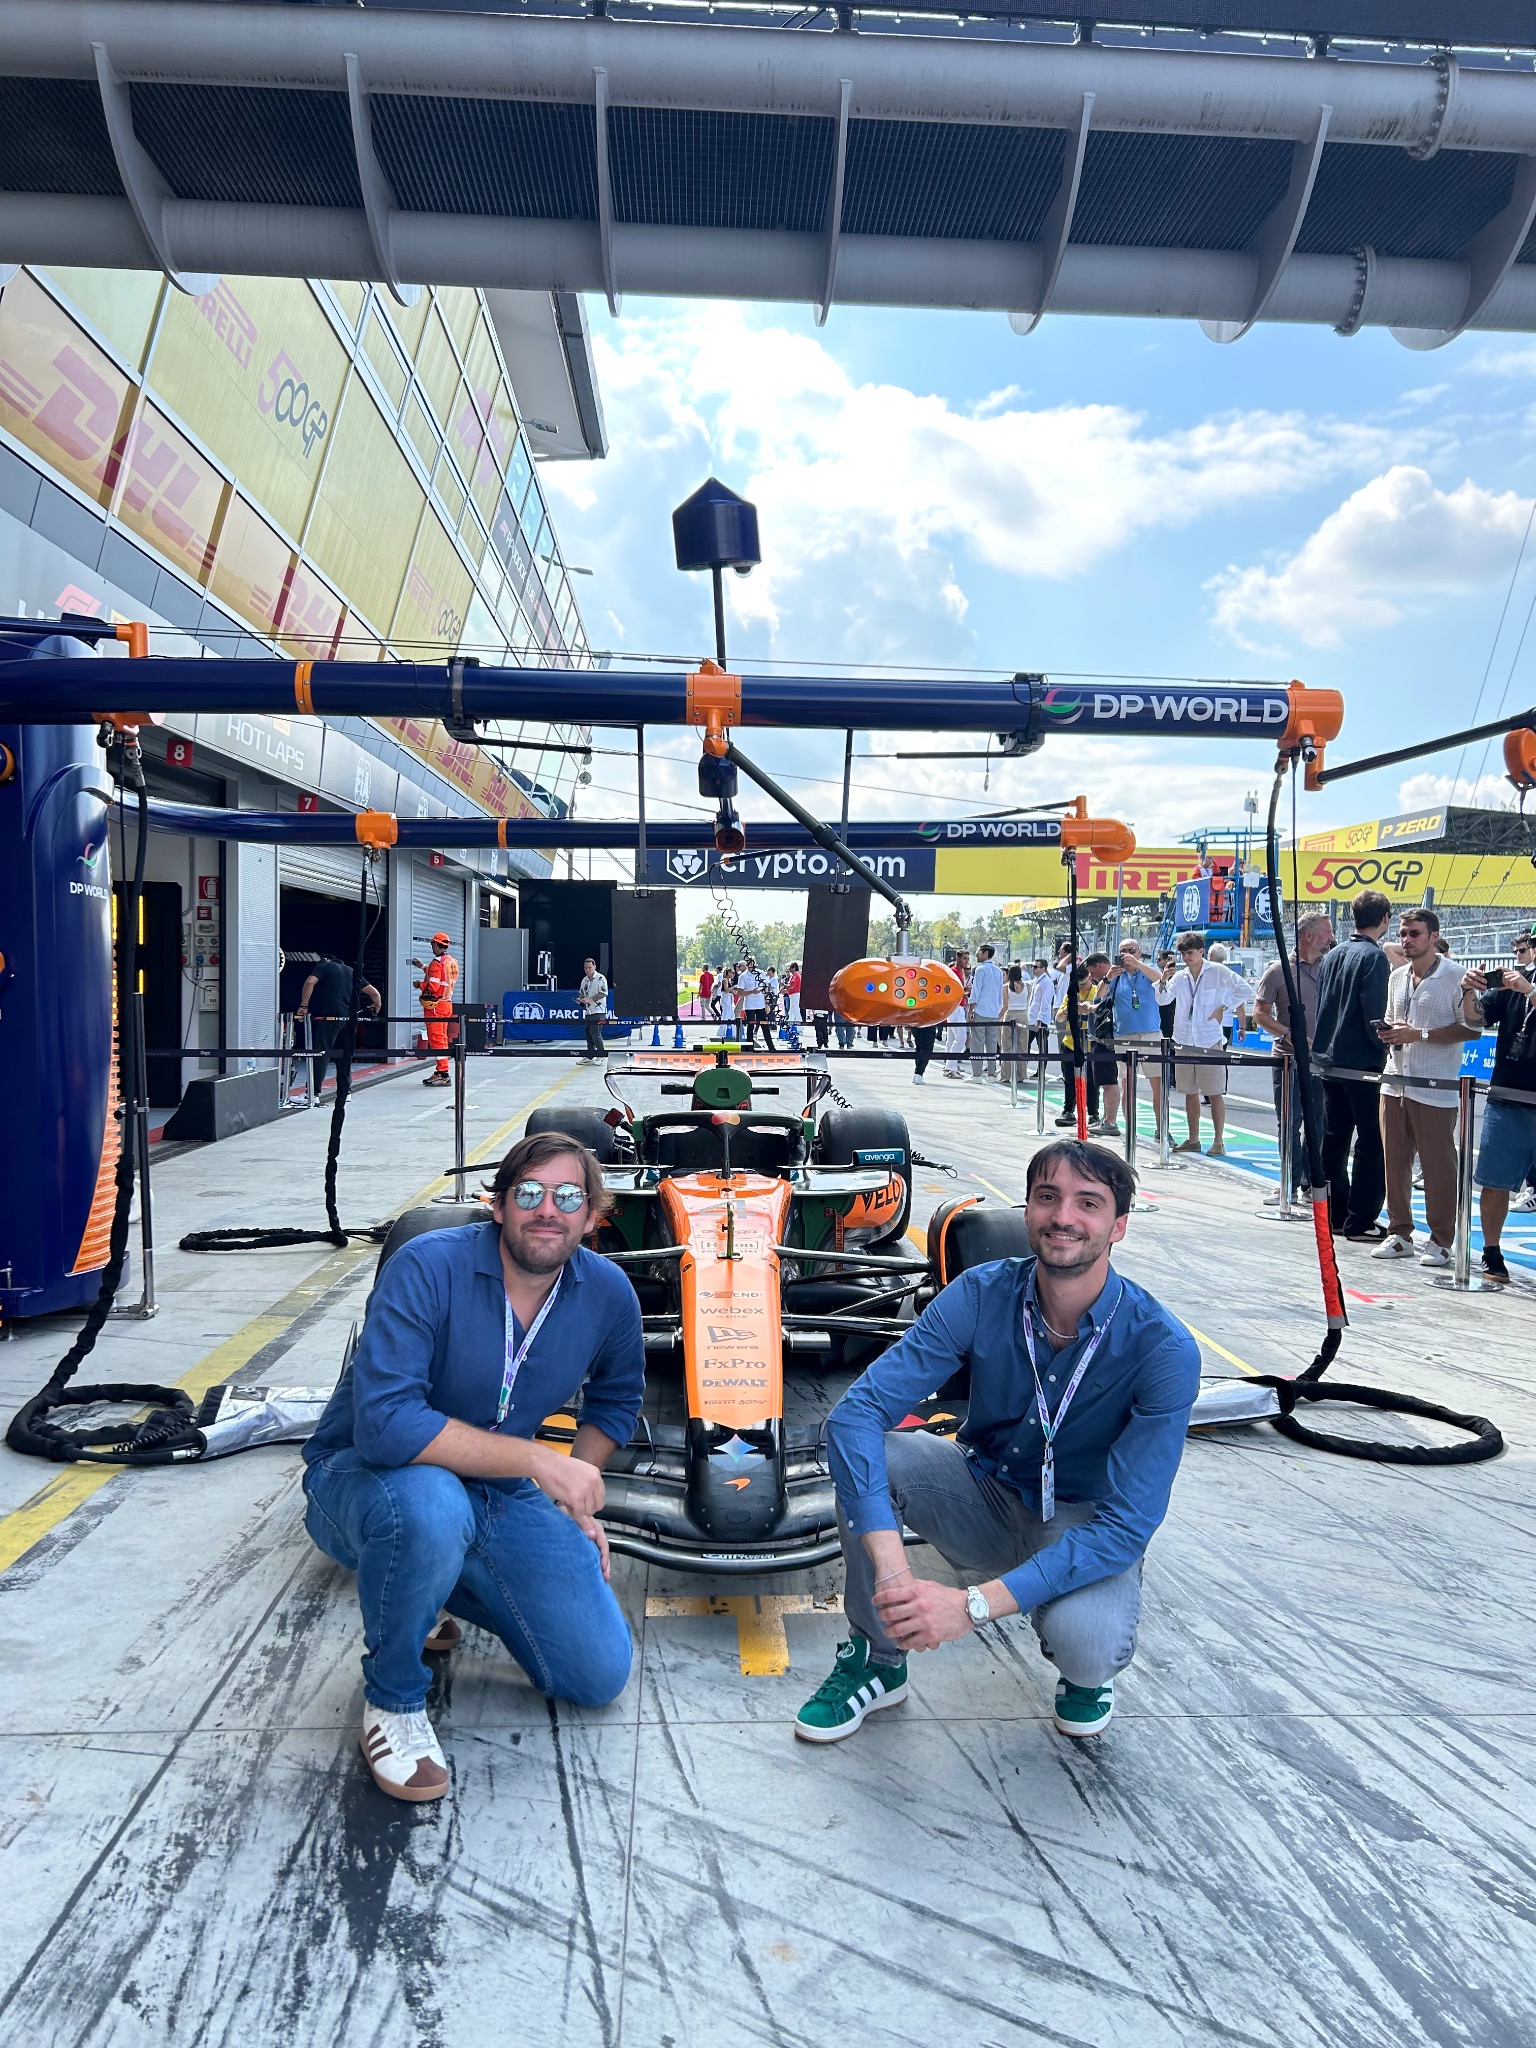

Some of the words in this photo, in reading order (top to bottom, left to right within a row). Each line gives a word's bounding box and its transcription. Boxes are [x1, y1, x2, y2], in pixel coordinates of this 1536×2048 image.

[193, 278, 257, 371] RELLI
[32, 345, 201, 549] DHL
[1093, 694, 1144, 719] DP
[1150, 695, 1288, 724] WORLD
[174, 744, 185, 761] 8
[227, 715, 265, 751] HOT
[266, 734, 305, 771] LAPS
[304, 798, 312, 810] 7
[947, 823, 976, 838] DP
[979, 822, 1061, 837] WORLD
[1380, 824, 1393, 839] P
[1393, 814, 1442, 836] ZERO
[433, 855, 440, 864] 5
[720, 849, 906, 878] crypto.om
[1075, 853, 1236, 890] PIRE
[1305, 858, 1423, 894] 500GP
[70, 881, 84, 895] DP
[84, 884, 109, 900] WORLD
[549, 1009, 579, 1019] PARC
[864, 1153, 895, 1161] avenga
[862, 1180, 900, 1213] VELO
[700, 1306, 764, 1315] webex
[702, 1358, 767, 1369] FxPro
